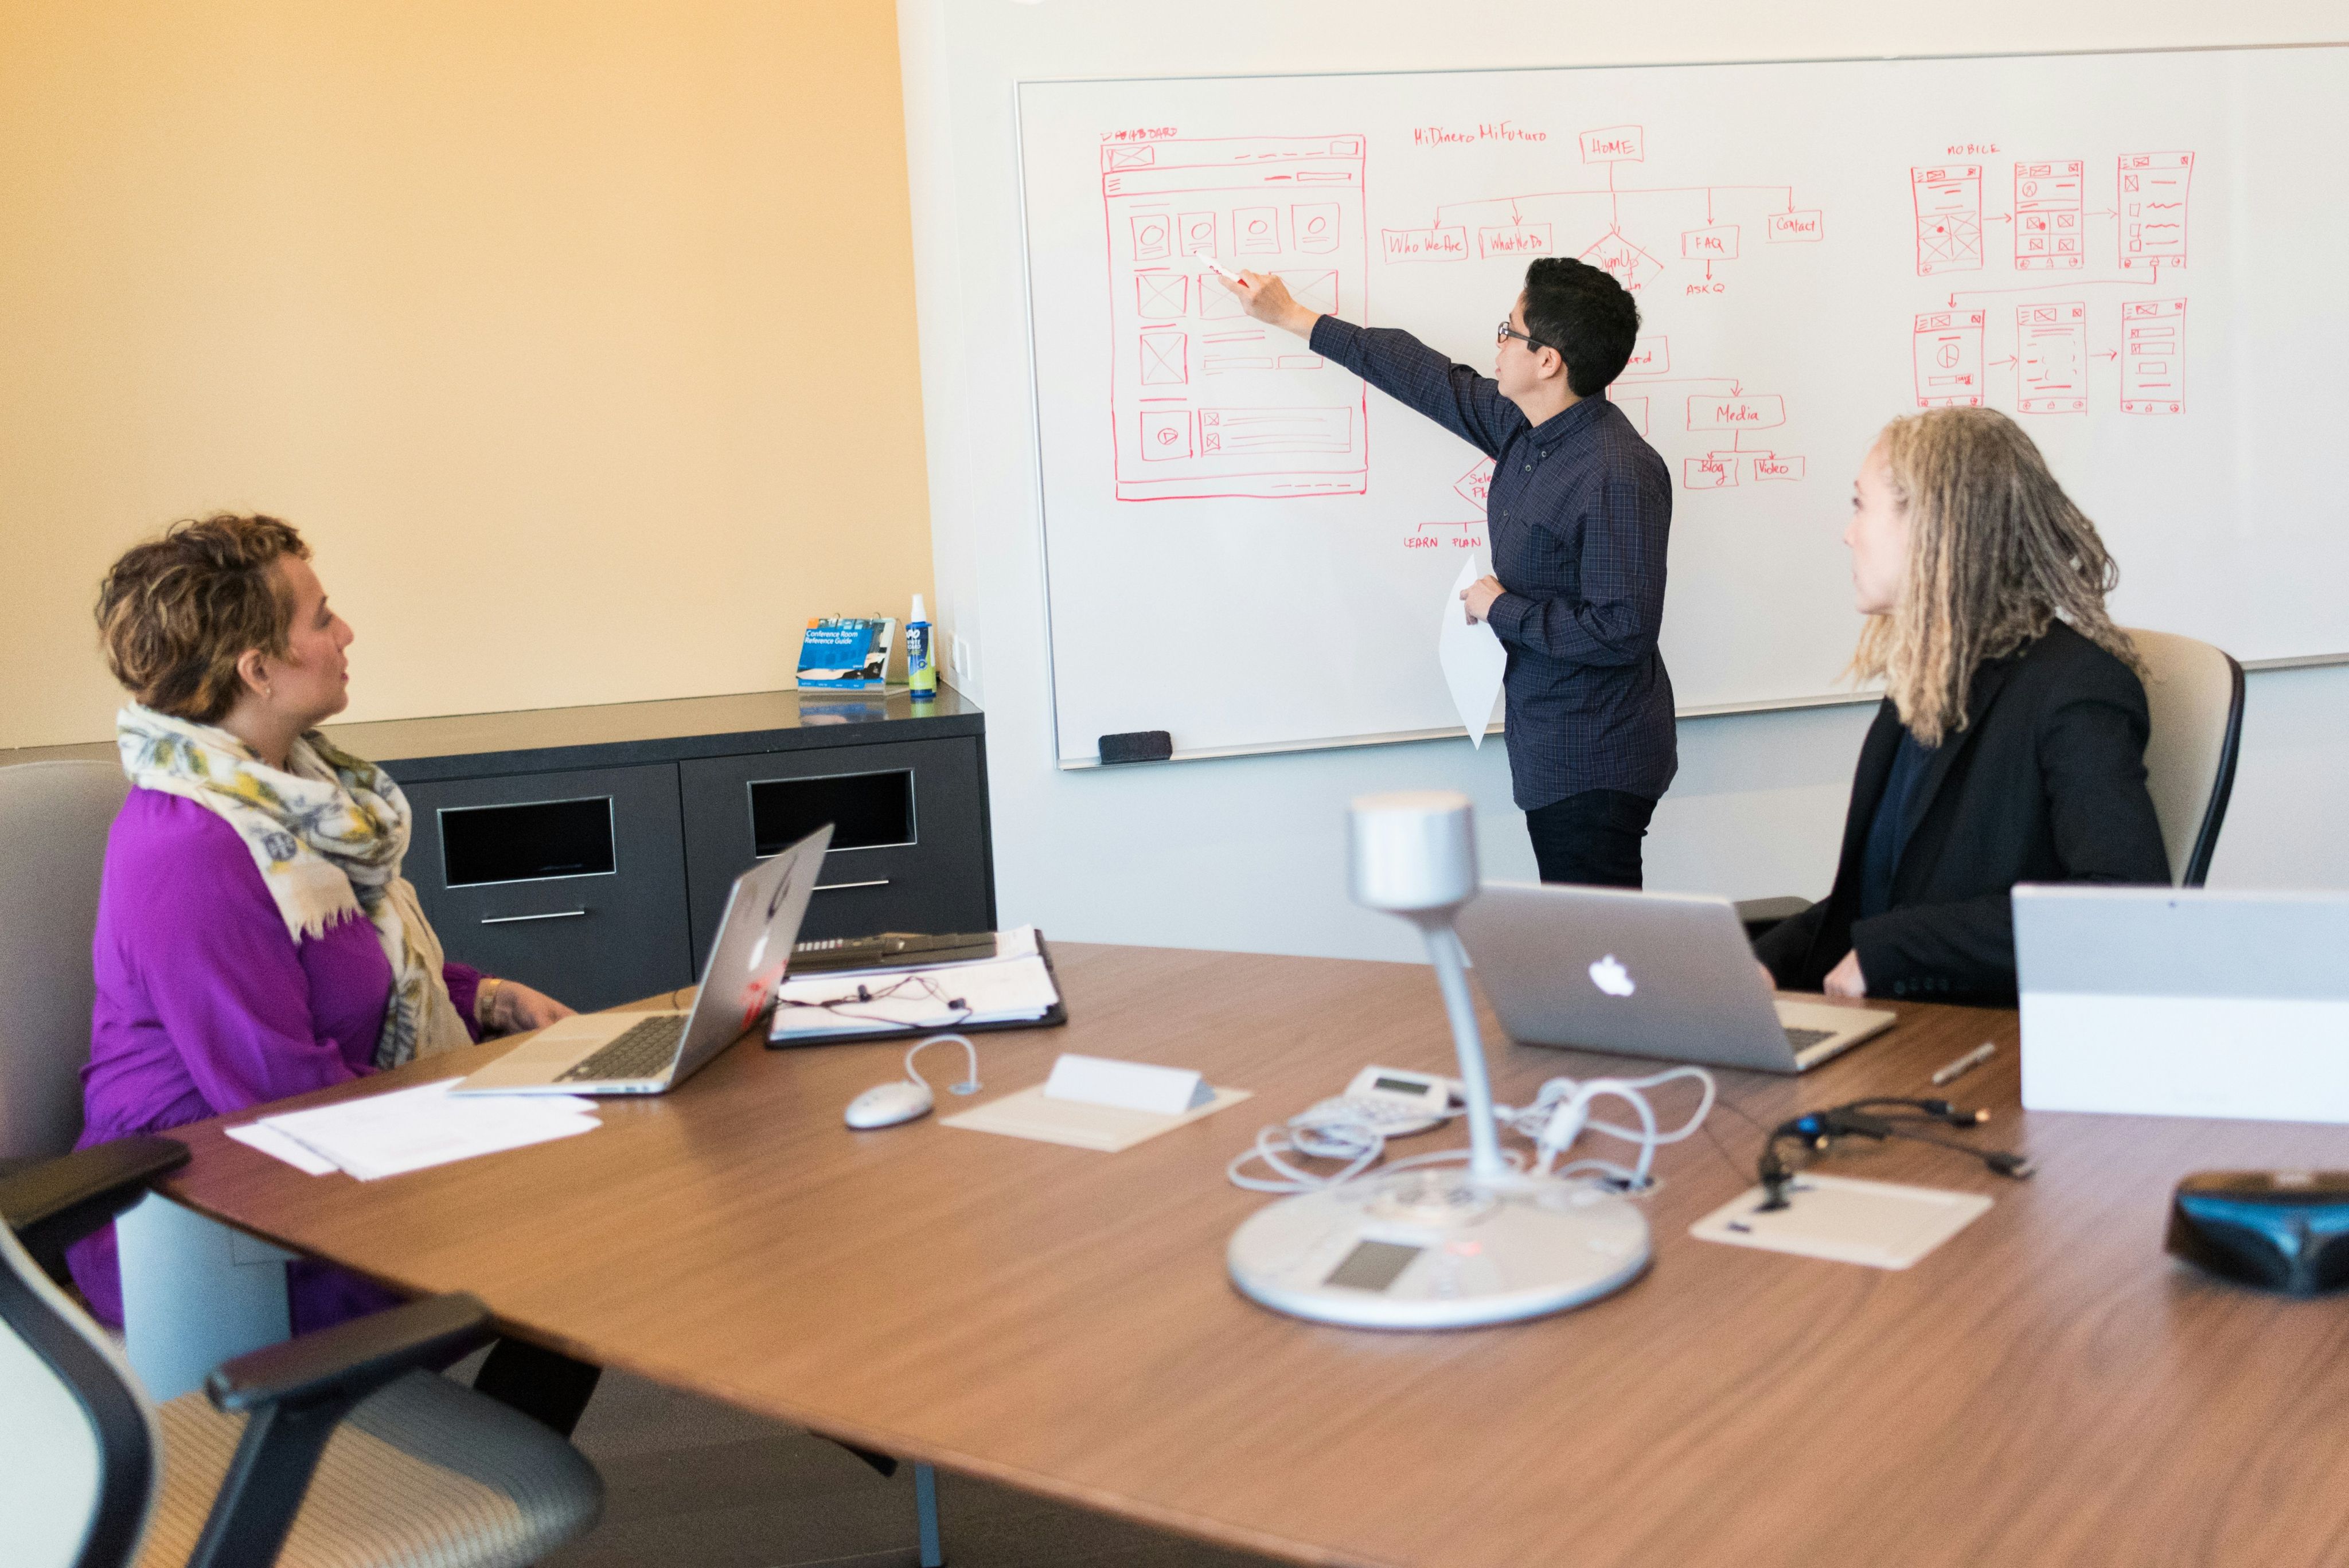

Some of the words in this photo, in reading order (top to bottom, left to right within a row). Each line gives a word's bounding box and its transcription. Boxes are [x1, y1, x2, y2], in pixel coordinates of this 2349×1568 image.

[1948, 144, 2000, 155] MOBILE
[1777, 217, 1815, 233] Contact
[1390, 233, 1419, 253] Who
[1696, 237, 1725, 253] FAQ
[1686, 284, 1710, 295] ASK
[1716, 404, 1759, 423] Media
[1698, 460, 1728, 486] Blog
[1759, 460, 1789, 475] Video
[1469, 472, 1492, 485] Sele
[1404, 537, 1438, 549] LEARN
[1451, 537, 1481, 548] PLAN
